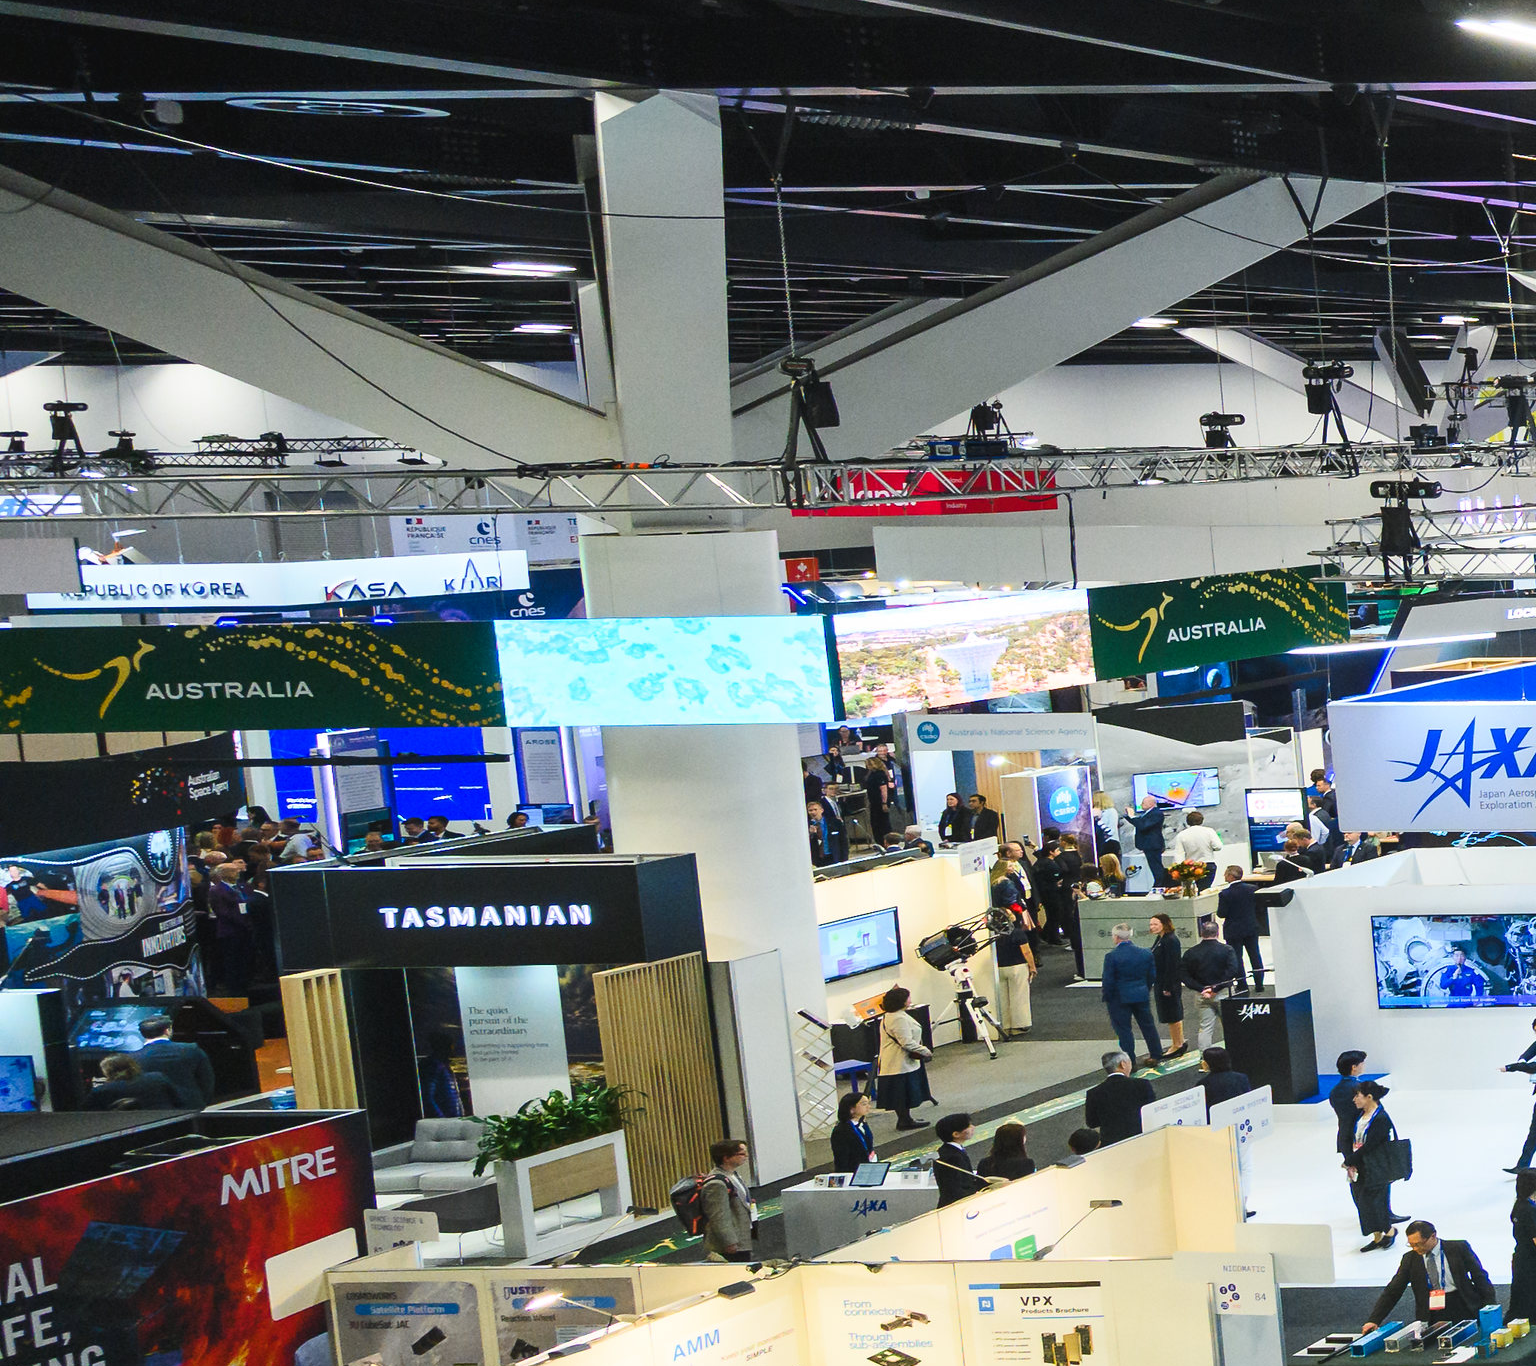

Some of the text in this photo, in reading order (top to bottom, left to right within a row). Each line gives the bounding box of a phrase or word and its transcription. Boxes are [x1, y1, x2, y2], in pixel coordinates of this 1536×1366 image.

[325, 578, 407, 601] KASA
[510, 606, 545, 618] cnes
[1166, 617, 1266, 644] AUSTRALIA
[146, 680, 313, 700] AUSTRALIA
[949, 727, 1088, 737] Australia's National Science Agency
[1480, 800, 1532, 811] Exploration
[379, 905, 592, 929] TASMANIAN
[1237, 1003, 1270, 1023] JAXA
[470, 1027, 528, 1036] extraordinary
[221, 1145, 337, 1206] MITRE
[1222, 1265, 1266, 1274] NICOMATIC
[1021, 1296, 1053, 1306] VPX
[1254, 1292, 1267, 1302] 84
[370, 1305, 445, 1314] Satellite Platform
[844, 1307, 905, 1317] connectors
[849, 1333, 893, 1342] Through
[673, 1329, 721, 1362] AMM
[849, 1340, 933, 1348] sub-assemblies
